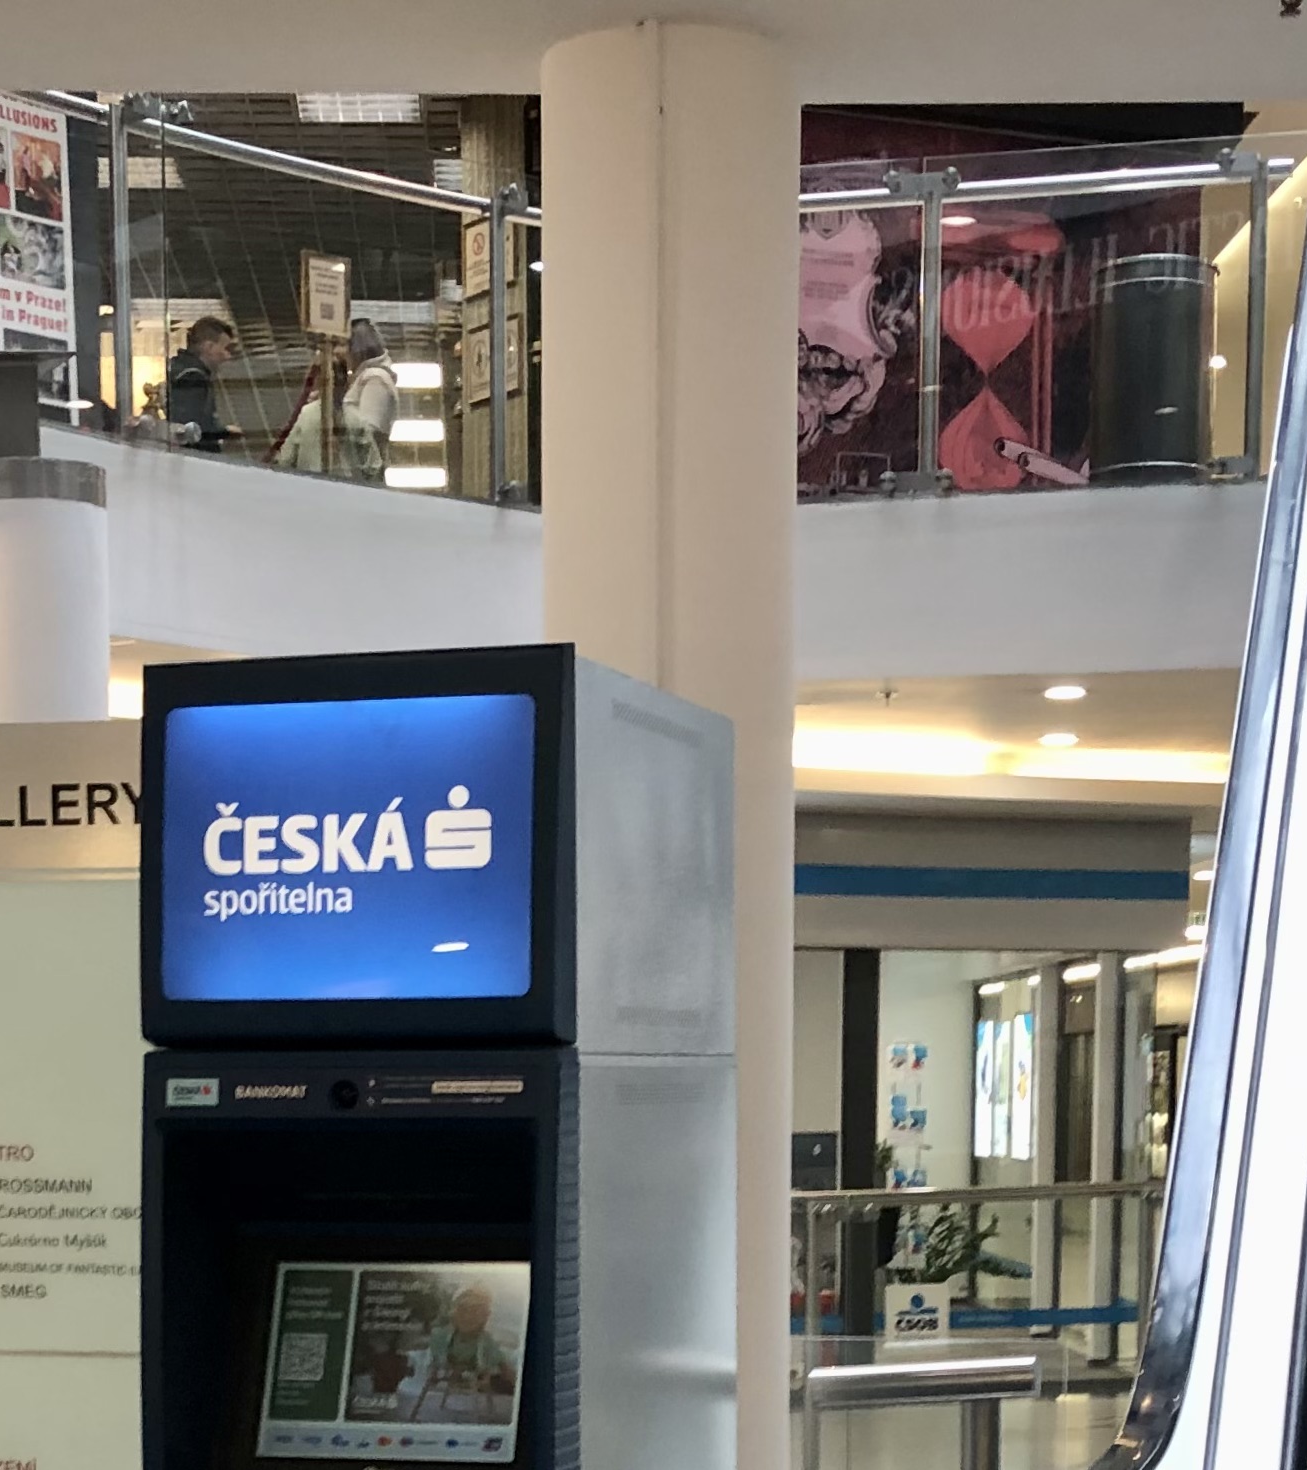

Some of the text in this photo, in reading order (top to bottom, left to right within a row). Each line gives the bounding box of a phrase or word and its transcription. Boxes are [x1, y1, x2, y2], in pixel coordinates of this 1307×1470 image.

[14, 291, 22, 302] v
[26, 290, 67, 313] Praze!
[2, 305, 14, 321] in
[18, 309, 69, 333] Prague!
[203, 797, 413, 876] ČESKÁ
[203, 881, 354, 922] spořitelna
[234, 1084, 309, 1101] BANKOMAT
[51, 1263, 64, 1274] OF
[66, 1264, 126, 1276] FANTASTIC
[0, 1284, 47, 1299] SMEG
